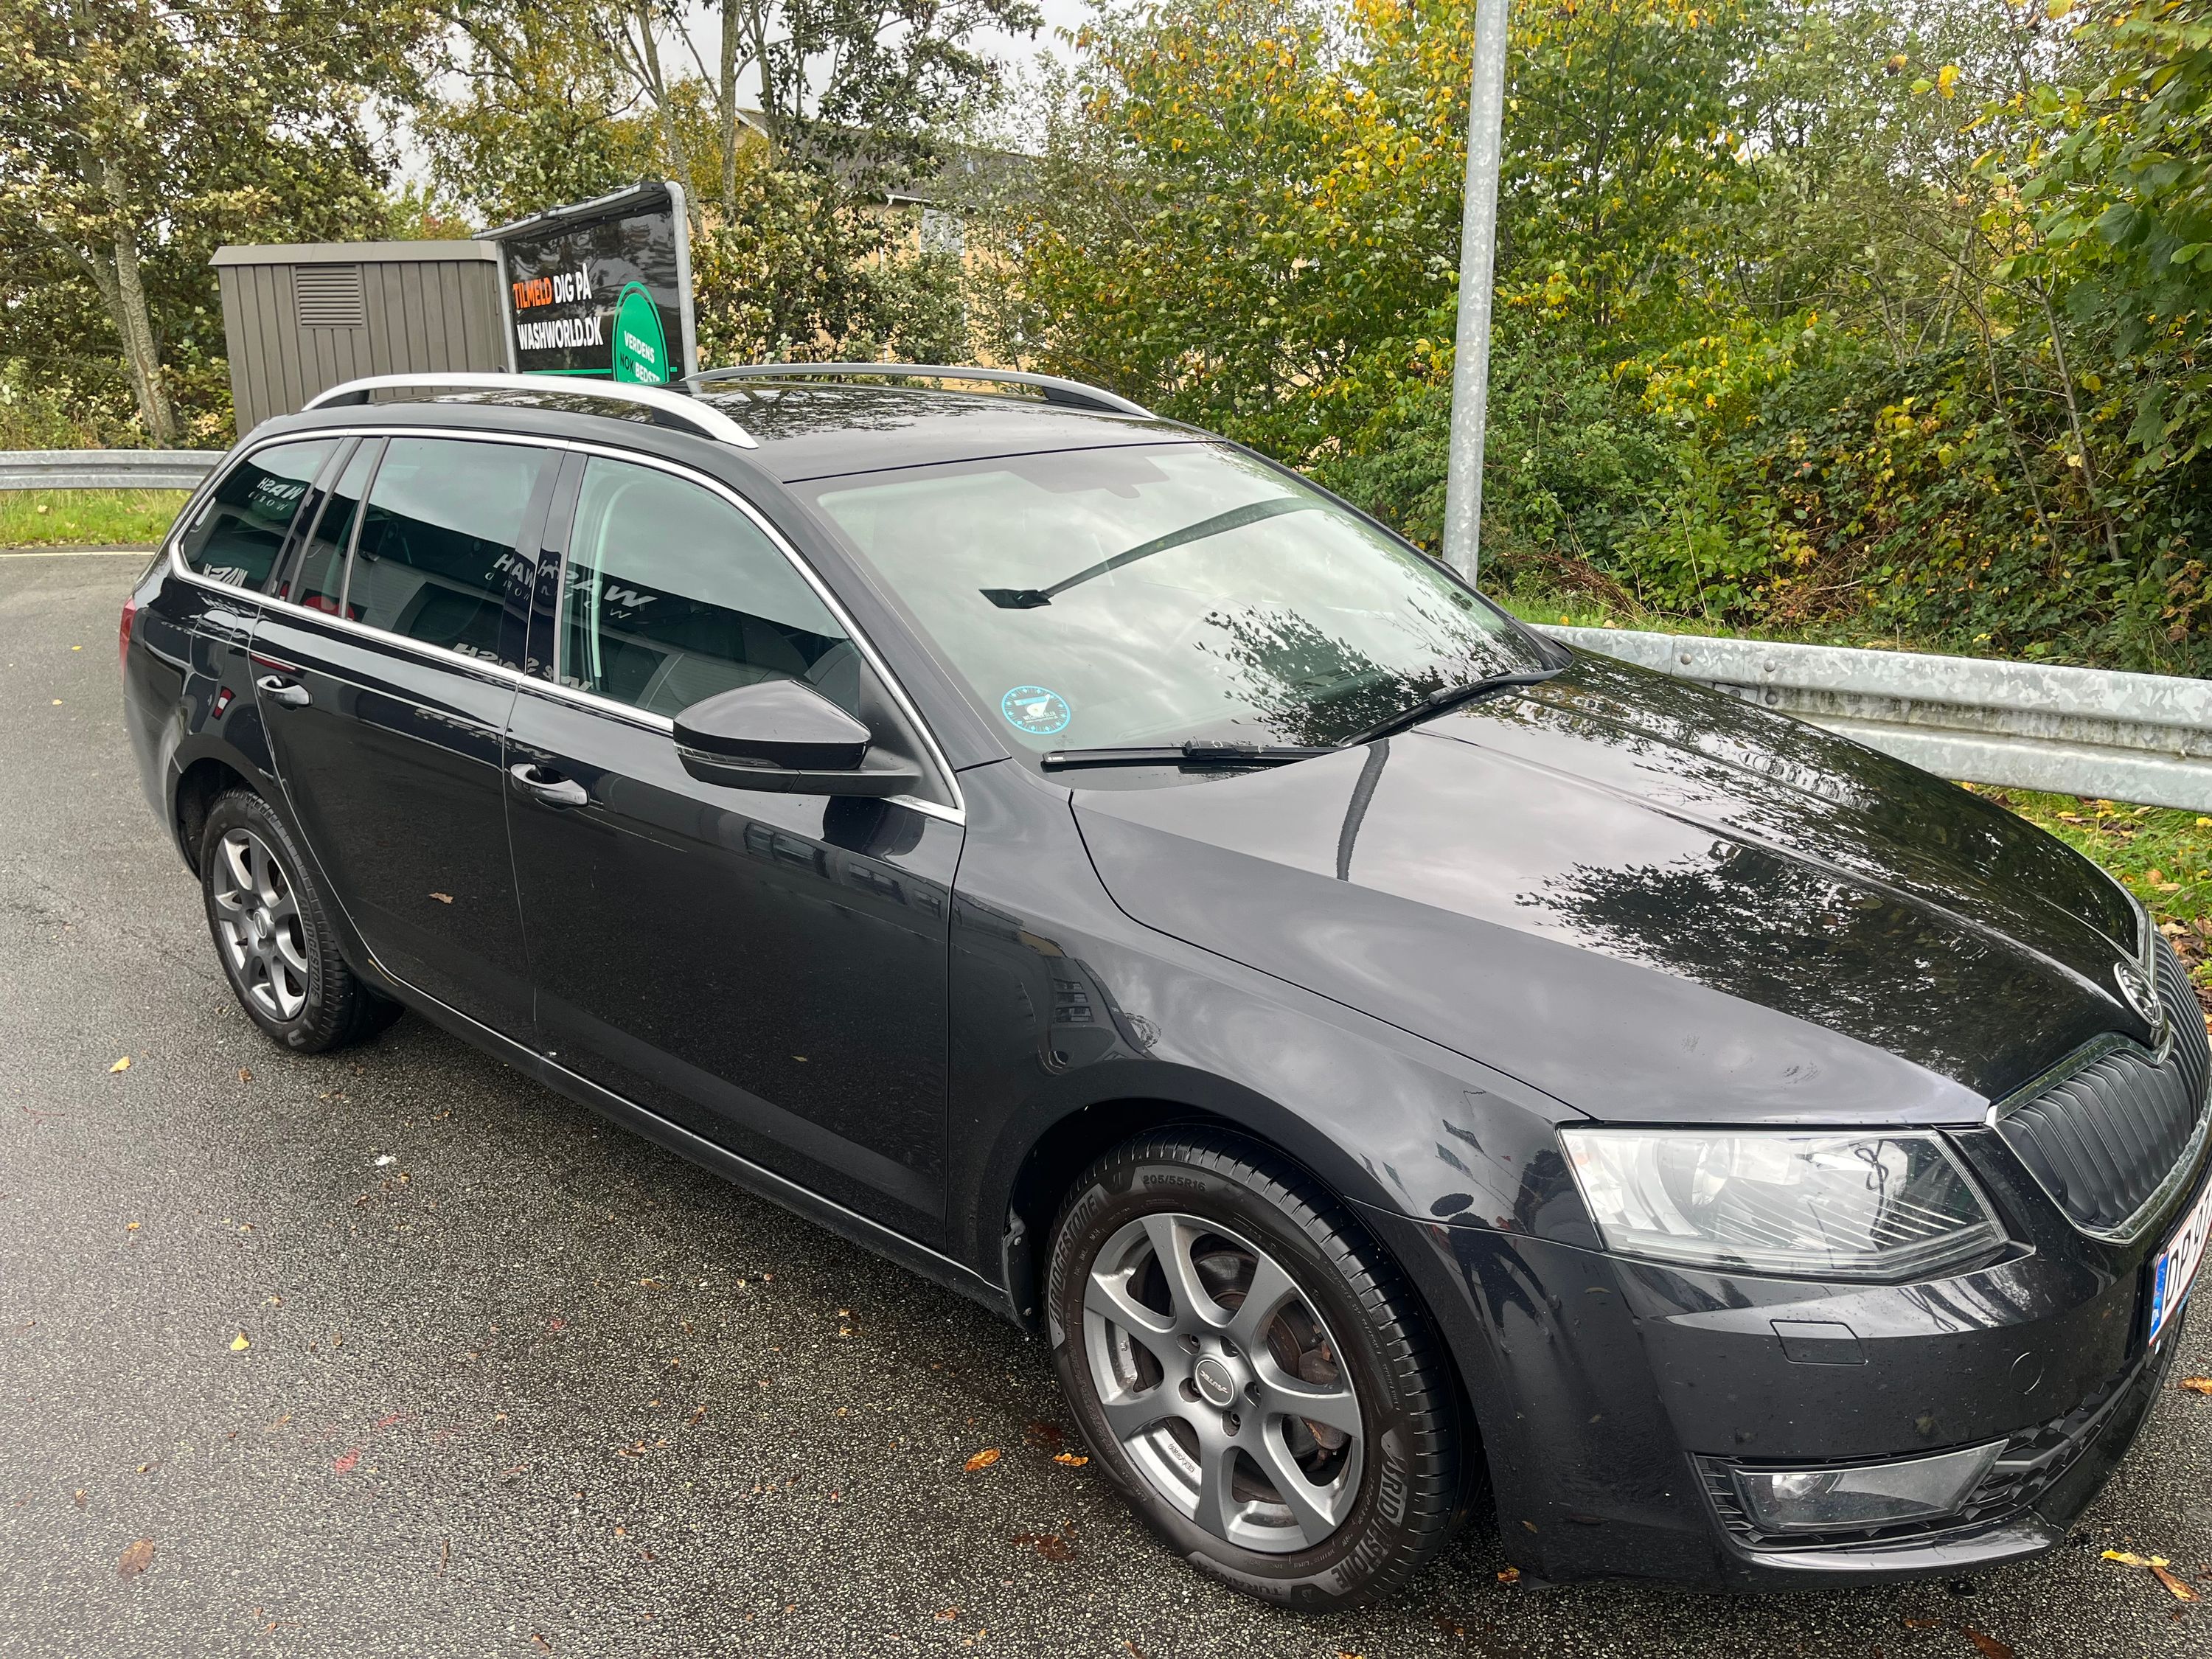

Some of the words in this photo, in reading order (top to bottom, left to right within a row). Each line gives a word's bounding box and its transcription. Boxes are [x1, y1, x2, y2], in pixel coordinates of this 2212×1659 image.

[513, 276, 552, 309] TILMELD
[553, 272, 574, 304] DIG
[575, 262, 592, 301] PÅ
[517, 316, 604, 350] WASHWORLD.DK
[624, 330, 655, 364] VERDENS
[620, 352, 634, 374] NOK
[1143, 1174, 1206, 1193] 205/55R16
[1049, 1194, 1100, 1324] BRIDGESTONE
[2165, 1228, 2191, 1312] DP
[1200, 1370, 1228, 1394] AUTEC
[1330, 1454, 1408, 1590] BRIDGESTONE
